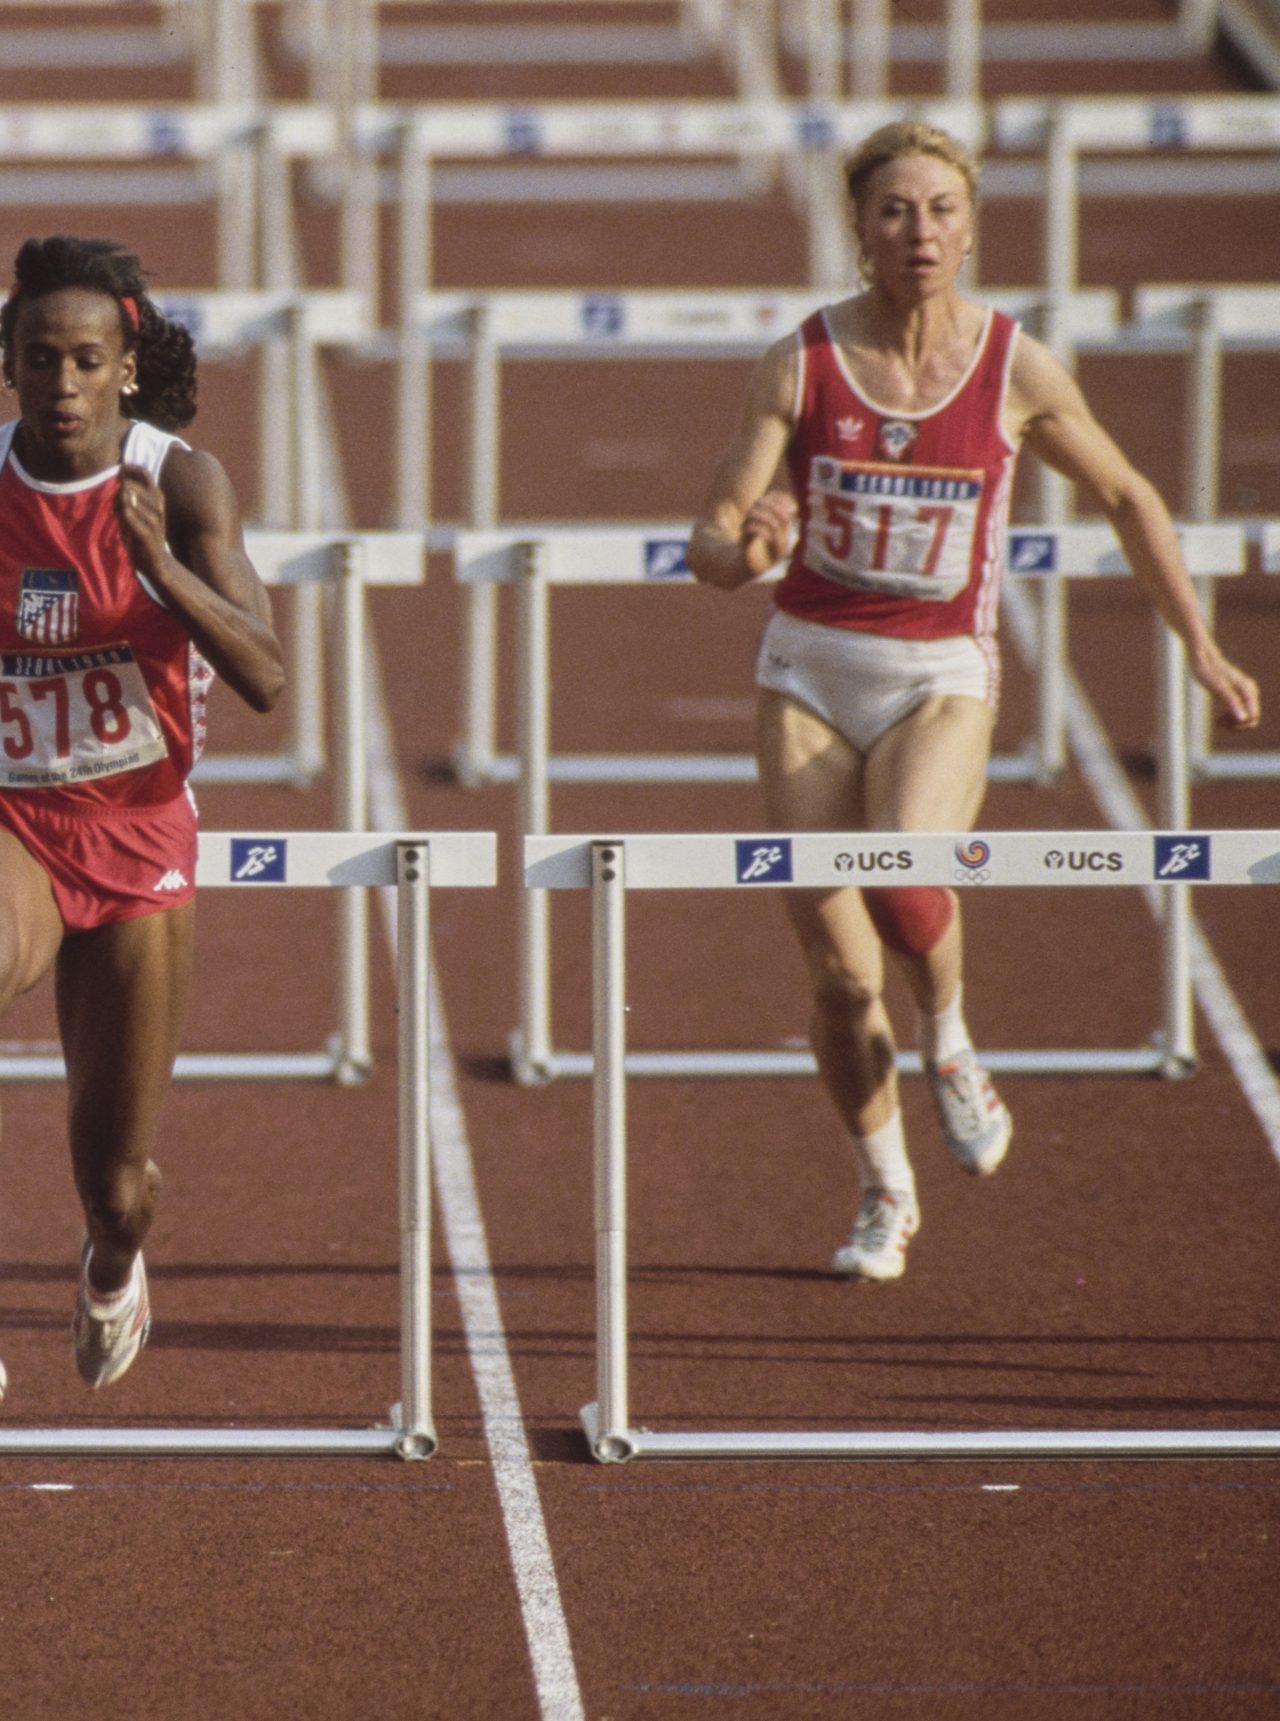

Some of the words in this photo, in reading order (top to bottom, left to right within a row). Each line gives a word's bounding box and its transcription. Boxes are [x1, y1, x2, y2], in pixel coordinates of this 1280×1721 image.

[823, 494, 955, 577] 517
[15, 656, 66, 676] SEOUL
[93, 752, 140, 773] Olympiad
[857, 850, 914, 872] UCS
[1068, 851, 1124, 872] UCS
